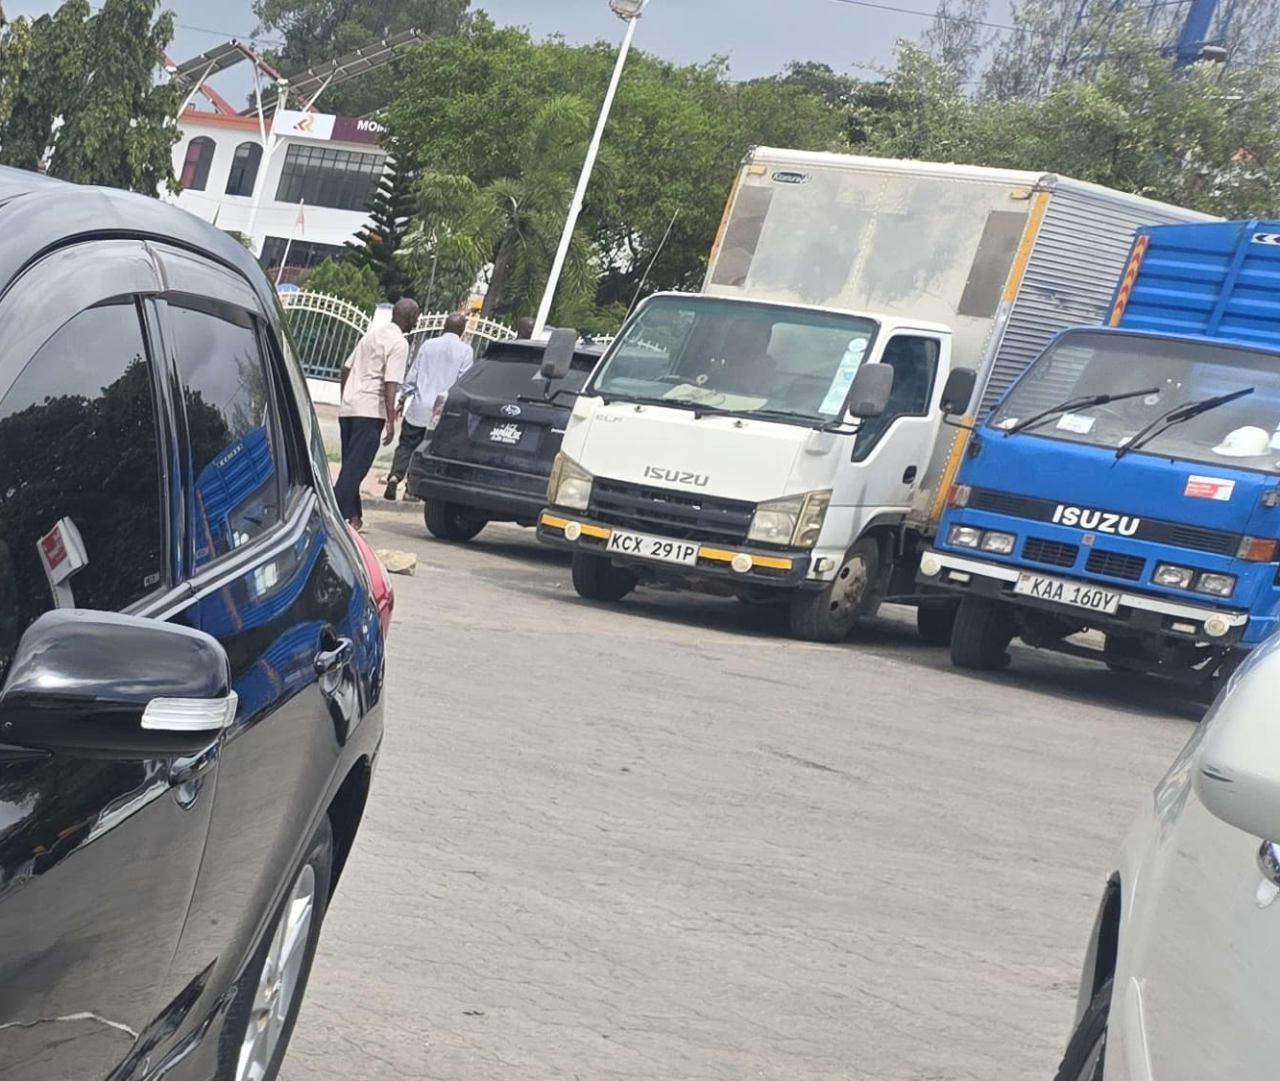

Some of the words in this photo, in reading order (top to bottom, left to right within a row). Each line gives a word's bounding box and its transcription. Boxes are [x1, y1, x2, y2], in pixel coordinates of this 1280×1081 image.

[643, 465, 710, 487] ISUZU
[1052, 504, 1140, 536] ISUZU
[611, 533, 643, 553] KCX
[650, 541, 695, 561] 291P
[1030, 578, 1064, 600] KAA
[1069, 587, 1116, 610] 160Y
